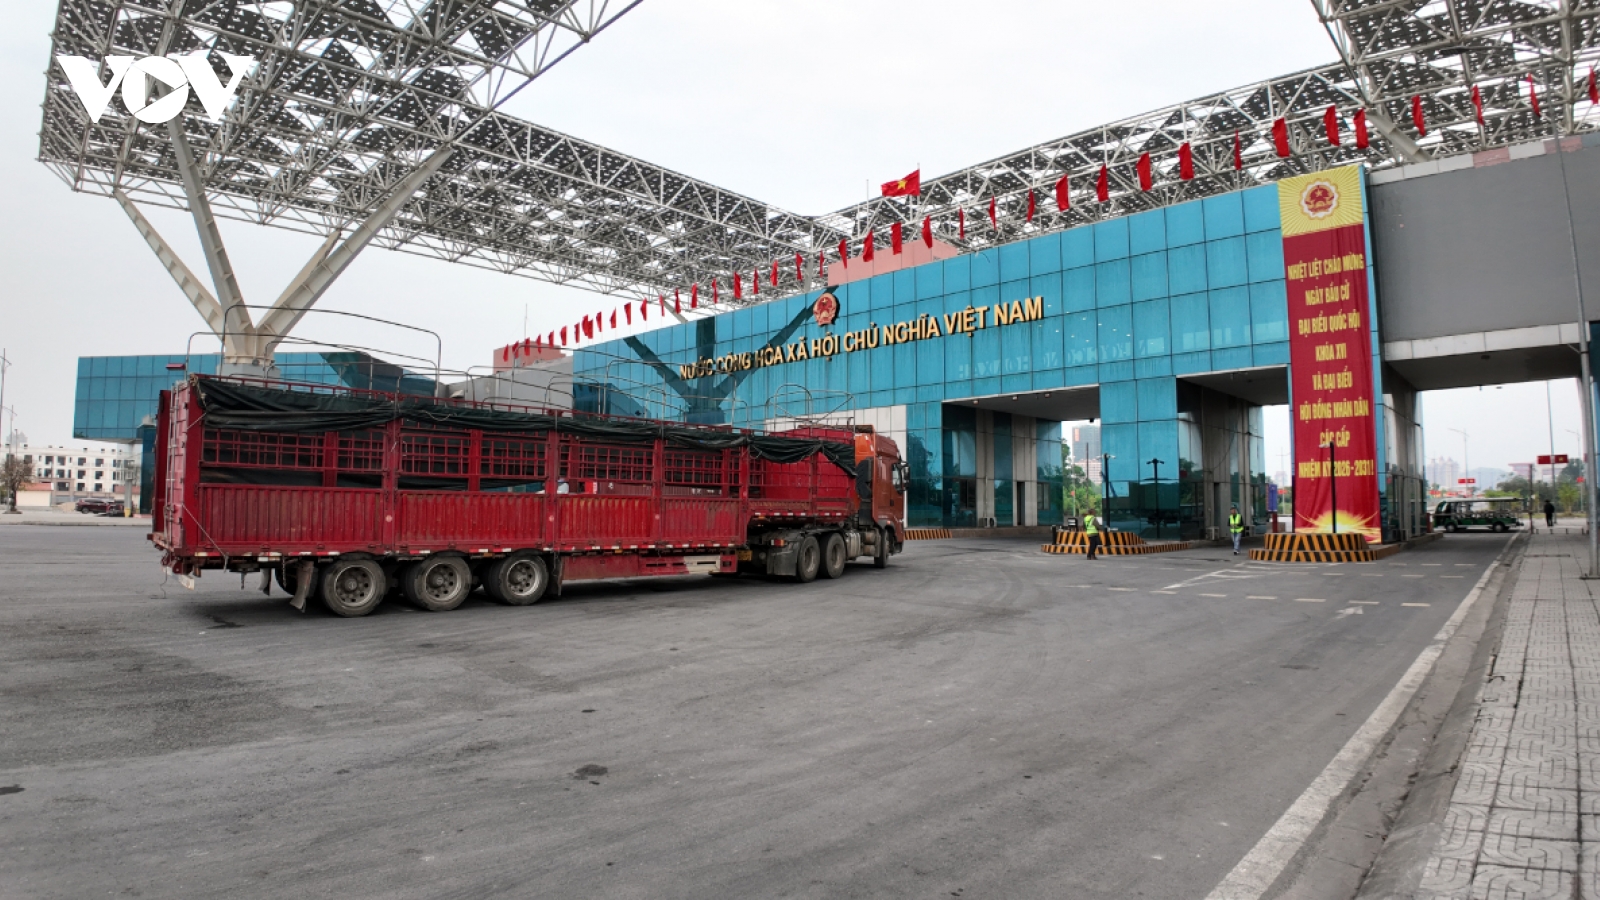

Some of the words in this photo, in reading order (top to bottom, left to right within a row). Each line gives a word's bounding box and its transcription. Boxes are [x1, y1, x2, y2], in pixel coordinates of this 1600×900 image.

[1287, 259, 1307, 282] NHIỆT
[1308, 257, 1322, 279] LIỆT
[1323, 254, 1341, 275] CHÀO
[1342, 251, 1364, 271] MỪNG
[1305, 285, 1323, 306] NGÀY
[1340, 279, 1350, 301] CỬ
[1298, 318, 1311, 338] ĐẠI
[1312, 310, 1327, 333] BIỂU
[1330, 308, 1346, 333] QUỐC
[1348, 308, 1360, 332] HỘI
[679, 355, 713, 380] NƯỚC
[716, 351, 752, 377] CỘNG
[755, 342, 784, 367] HÒA
[786, 336, 807, 362] XÃ
[811, 331, 840, 362] HỘI
[843, 322, 878, 353] CHỦ
[883, 313, 941, 345] NGHĨA
[943, 305, 989, 337] VIỆT
[993, 296, 1043, 327] NAM
[1315, 341, 1334, 362] KHÓA
[1335, 343, 1346, 360] XVI
[1312, 370, 1322, 390] VÀ
[1323, 373, 1336, 393] ĐẠI
[1337, 366, 1352, 389] BIỂU
[1300, 400, 1312, 424] HỘI
[1334, 398, 1353, 418] NHÂN
[1354, 396, 1369, 416] DÂN
[1336, 425, 1350, 448] CẤP
[1298, 458, 1321, 481] NHIỆM
